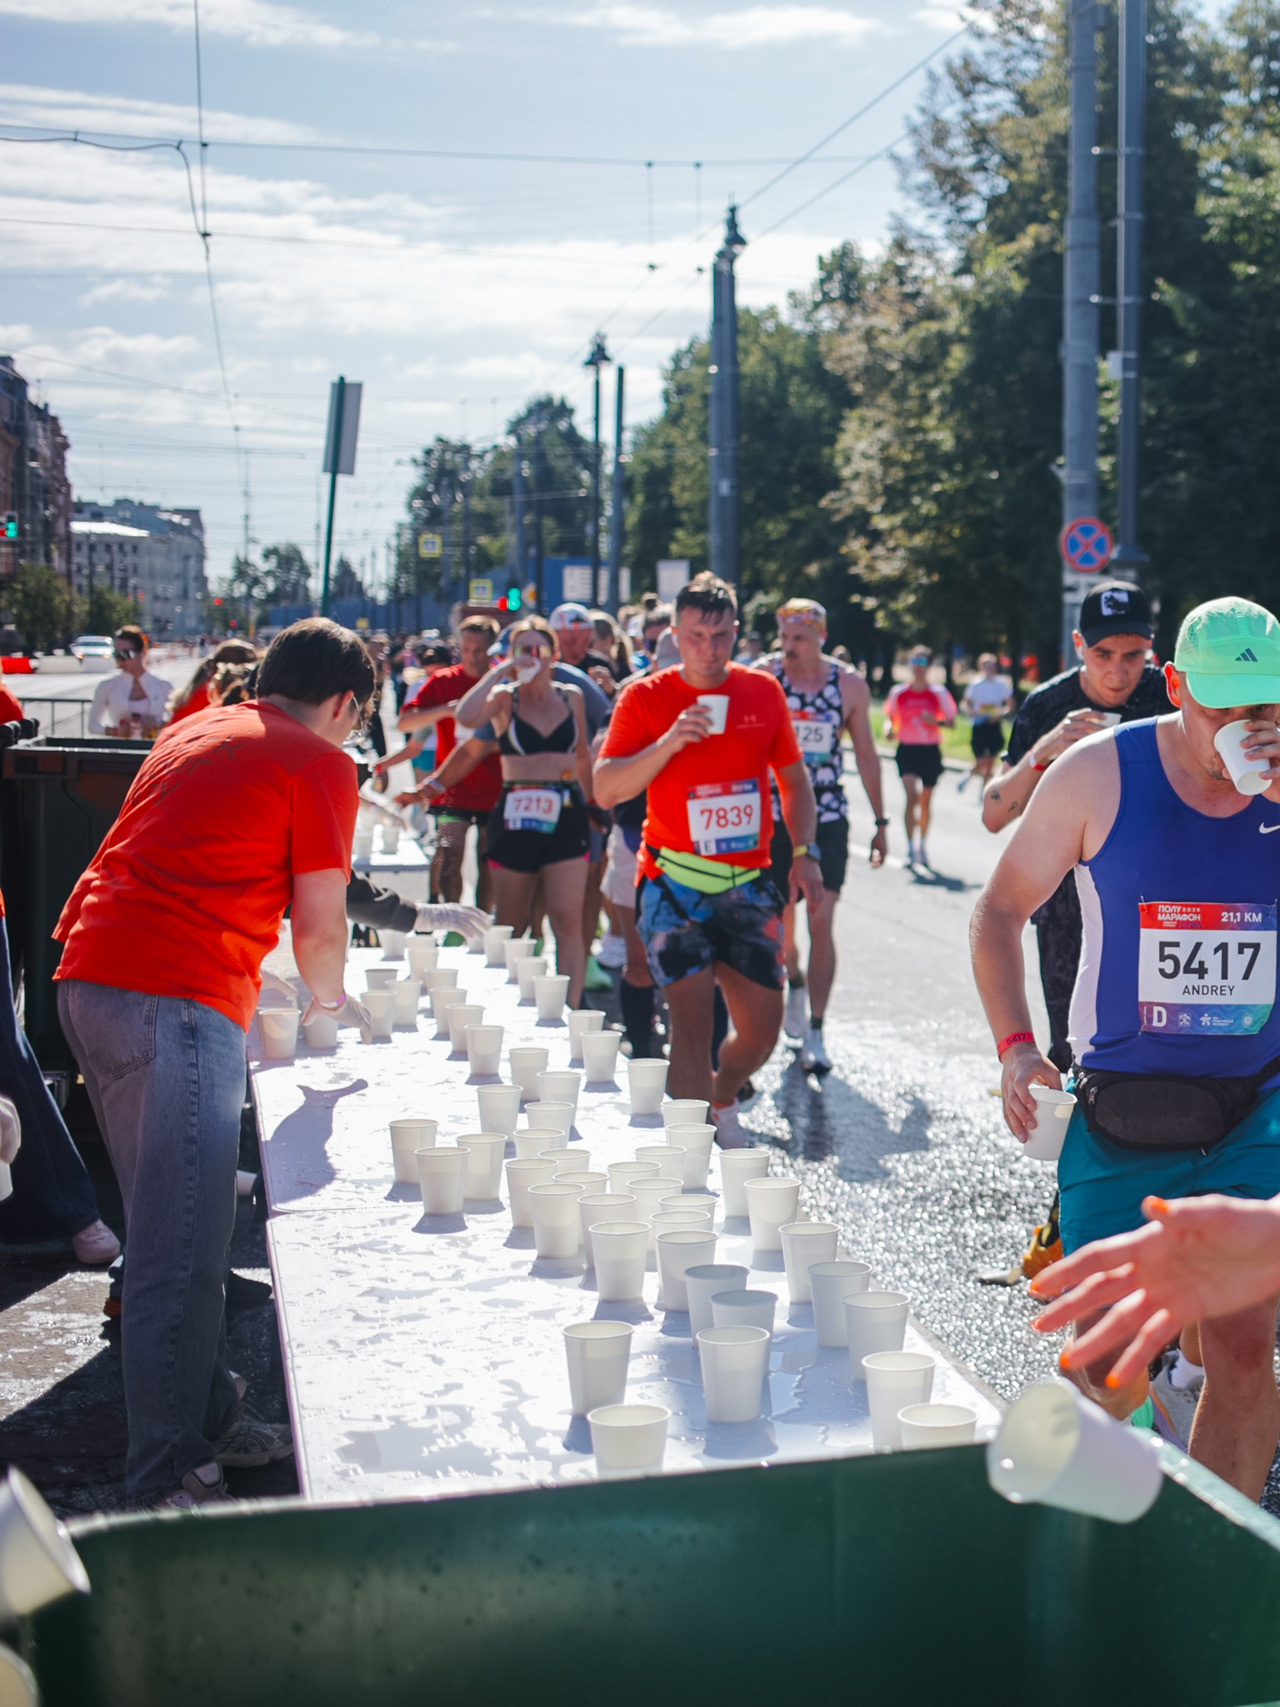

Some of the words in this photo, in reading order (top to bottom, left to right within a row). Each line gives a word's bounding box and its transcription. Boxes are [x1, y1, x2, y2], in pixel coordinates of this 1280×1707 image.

[513, 798, 554, 815] 7213
[700, 804, 754, 829] 7839
[1158, 905, 1181, 913] ПОЛУ
[1158, 913, 1201, 921] МАРАФОН
[1221, 911, 1241, 923] 21,1
[1244, 912, 1263, 922] КМ
[1158, 941, 1261, 981] 5417
[1182, 985, 1235, 996] ANDREY
[1152, 1005, 1167, 1027] D
